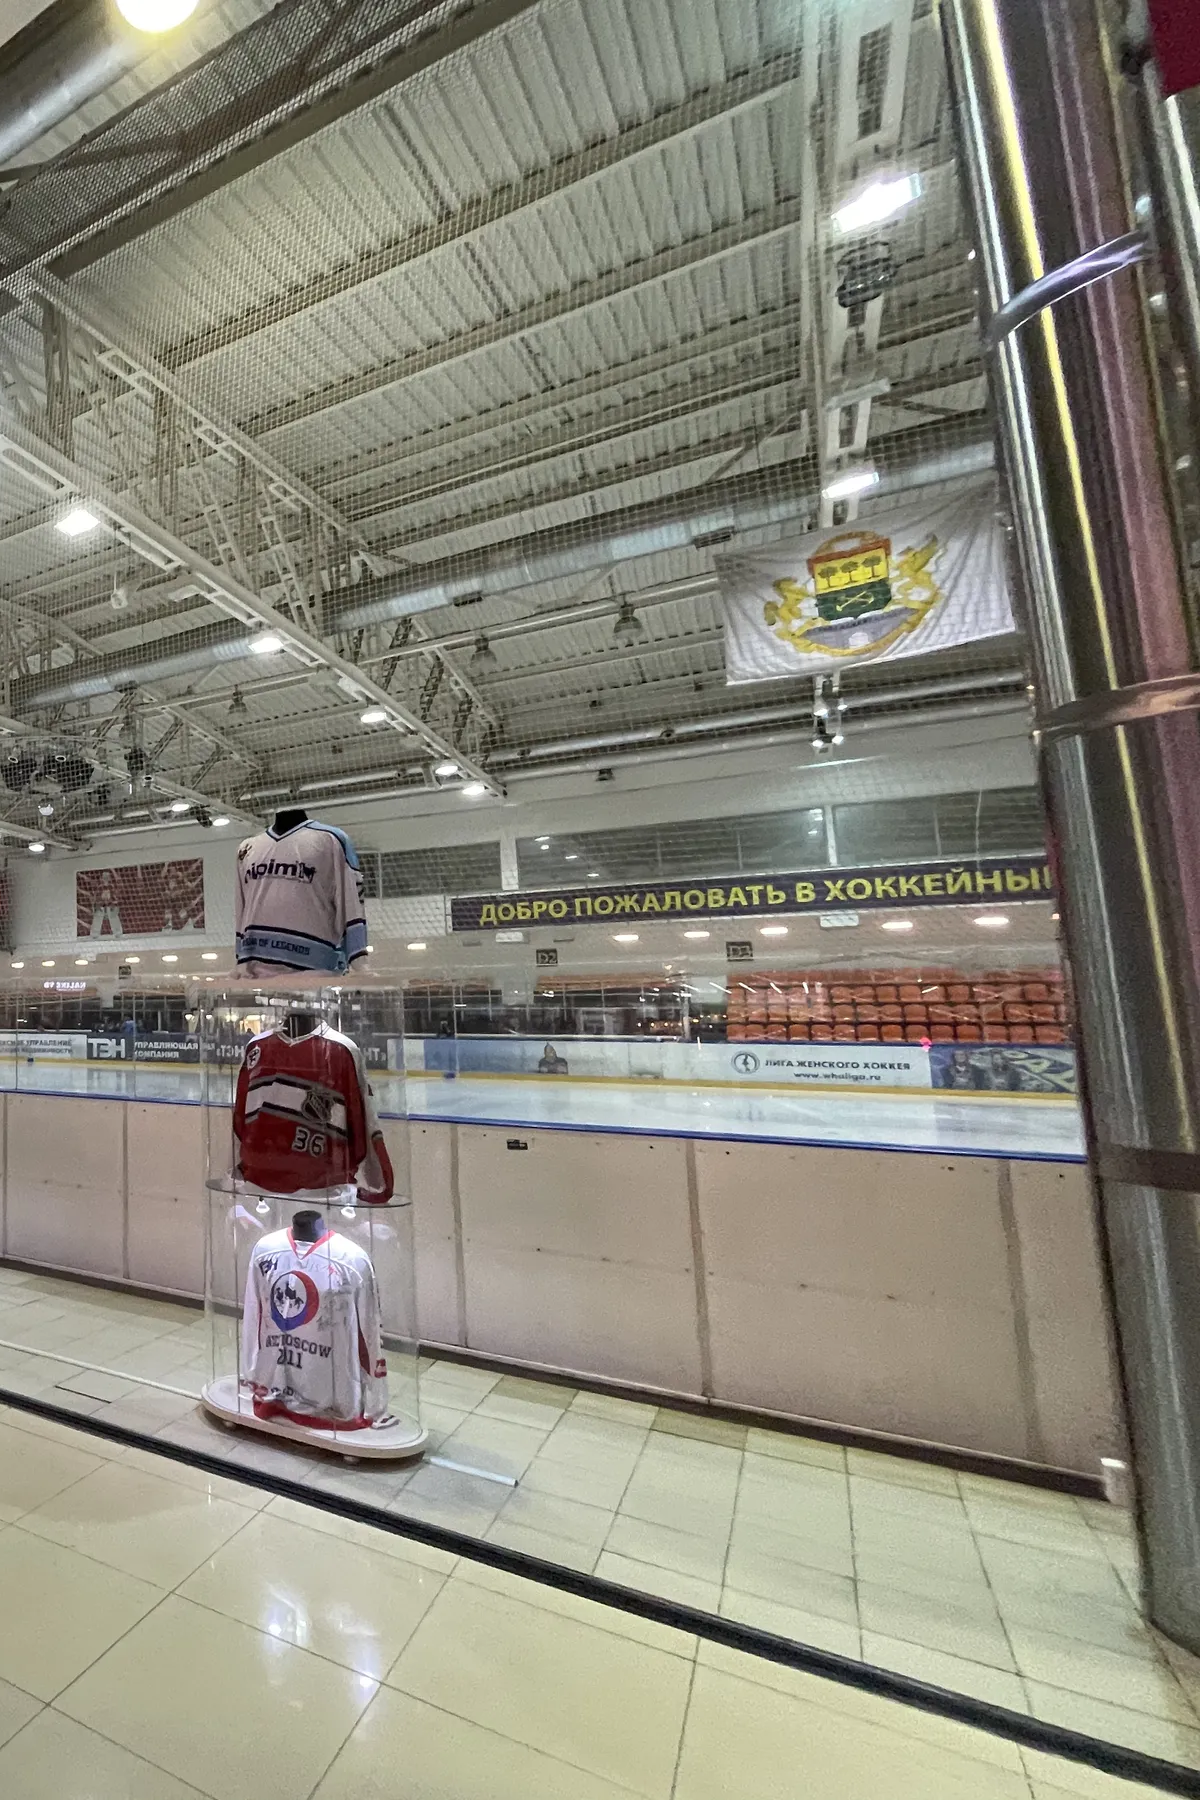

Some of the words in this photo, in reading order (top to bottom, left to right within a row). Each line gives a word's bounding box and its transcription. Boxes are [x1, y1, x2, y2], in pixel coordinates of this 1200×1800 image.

[480, 900, 568, 926] ДОБРО
[574, 883, 787, 917] ПОЖАЛОВАТЬ
[796, 881, 816, 904] В
[796, 1061, 860, 1069] ЖЕНСКОГО
[863, 1062, 910, 1070] ХОККЕЯ
[293, 1127, 327, 1157] 36
